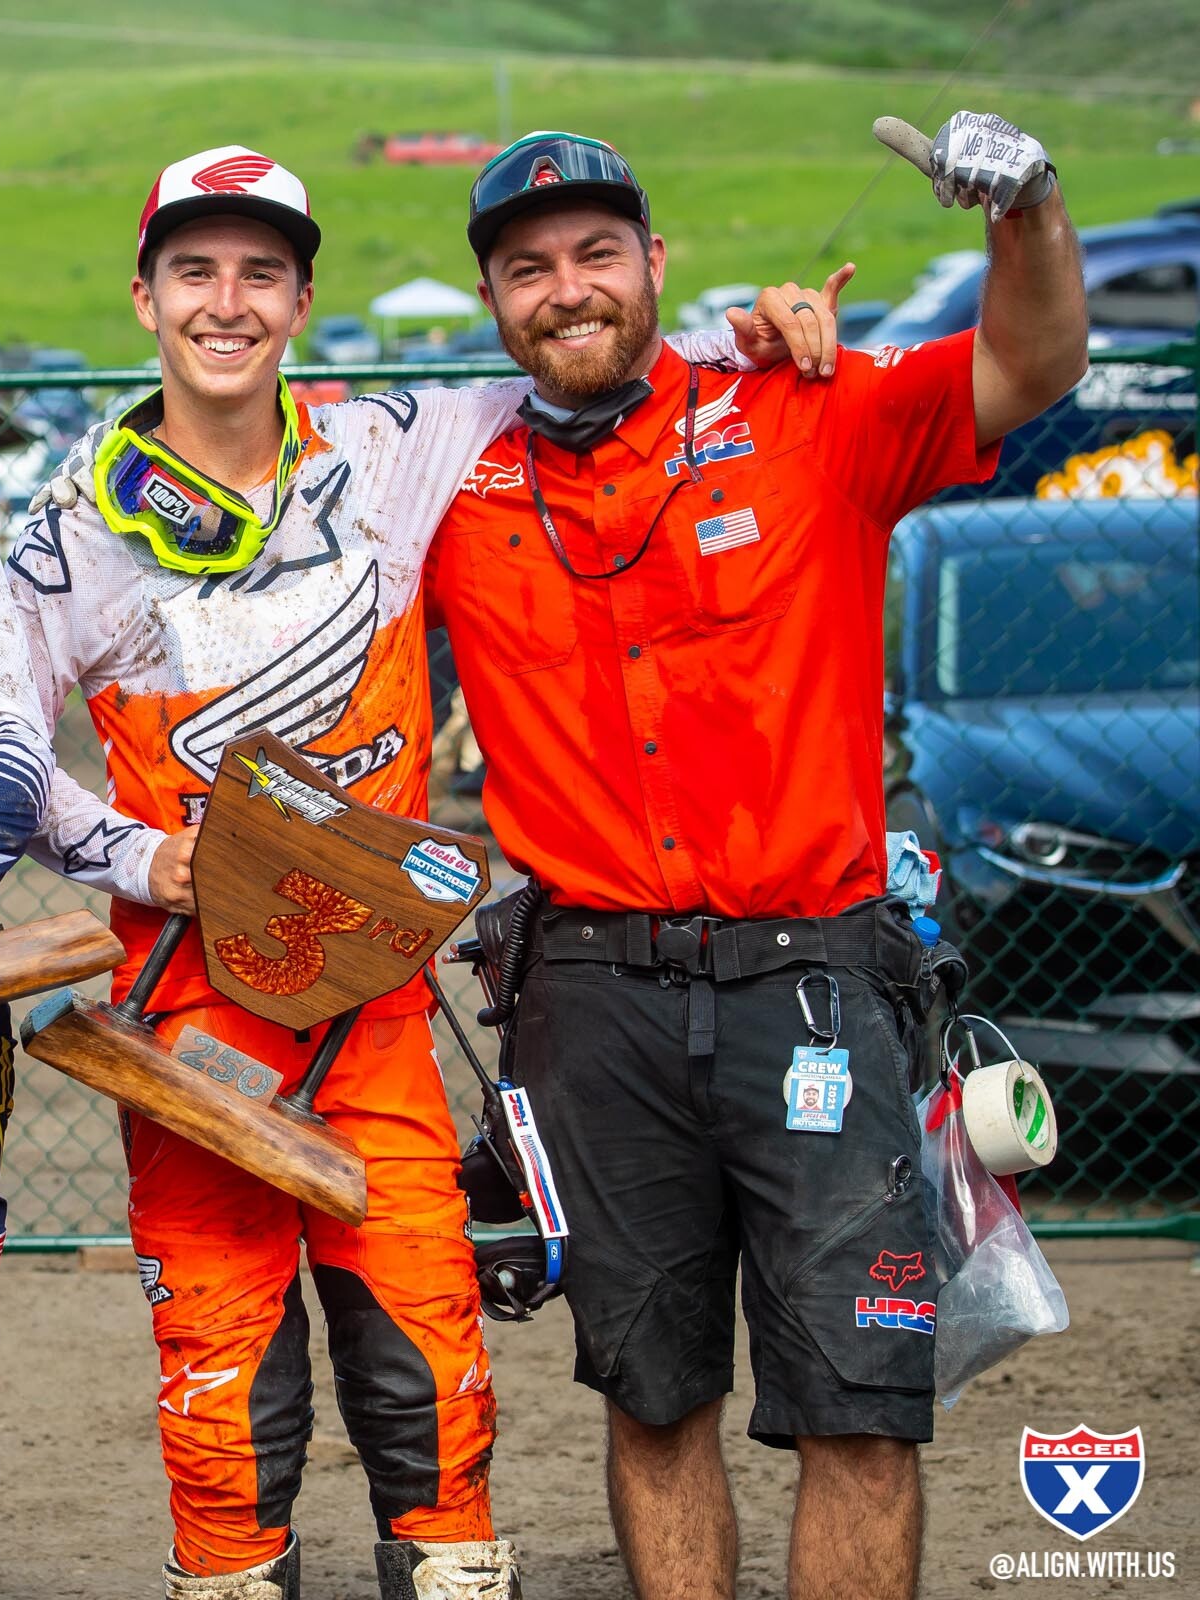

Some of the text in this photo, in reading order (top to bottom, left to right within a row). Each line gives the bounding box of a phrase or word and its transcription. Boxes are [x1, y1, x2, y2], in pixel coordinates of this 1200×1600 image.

[149, 483, 189, 517] 100%
[258, 760, 351, 811] Thunder
[262, 781, 334, 825] Valley
[407, 854, 473, 893] MOTOCROSS
[424, 844, 457, 865] LUCAS
[178, 1035, 274, 1098] 250
[798, 1062, 842, 1074] CREW
[827, 1085, 837, 1110] 2021
[856, 1297, 936, 1336] HRC
